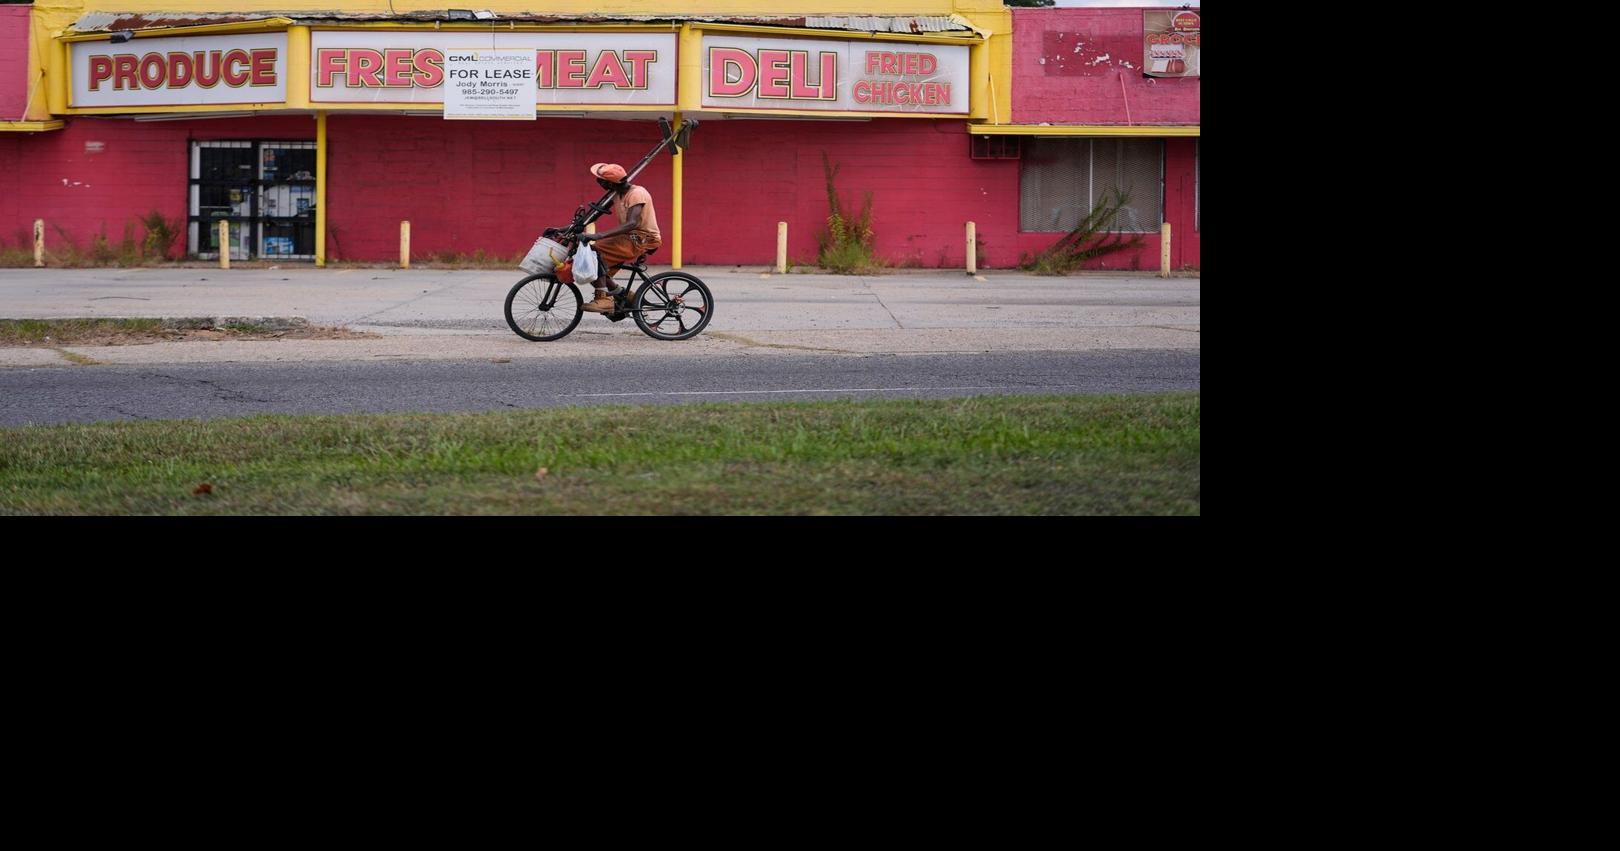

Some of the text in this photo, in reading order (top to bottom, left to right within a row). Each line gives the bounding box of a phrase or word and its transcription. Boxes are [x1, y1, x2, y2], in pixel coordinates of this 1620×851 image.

[88, 48, 278, 92] PRODUCE
[317, 48, 444, 88] FRES
[450, 70, 531, 79] FOR LEASE
[708, 46, 837, 101] DELI
[865, 50, 938, 75] FRIED
[852, 80, 952, 106] CHICKEN
